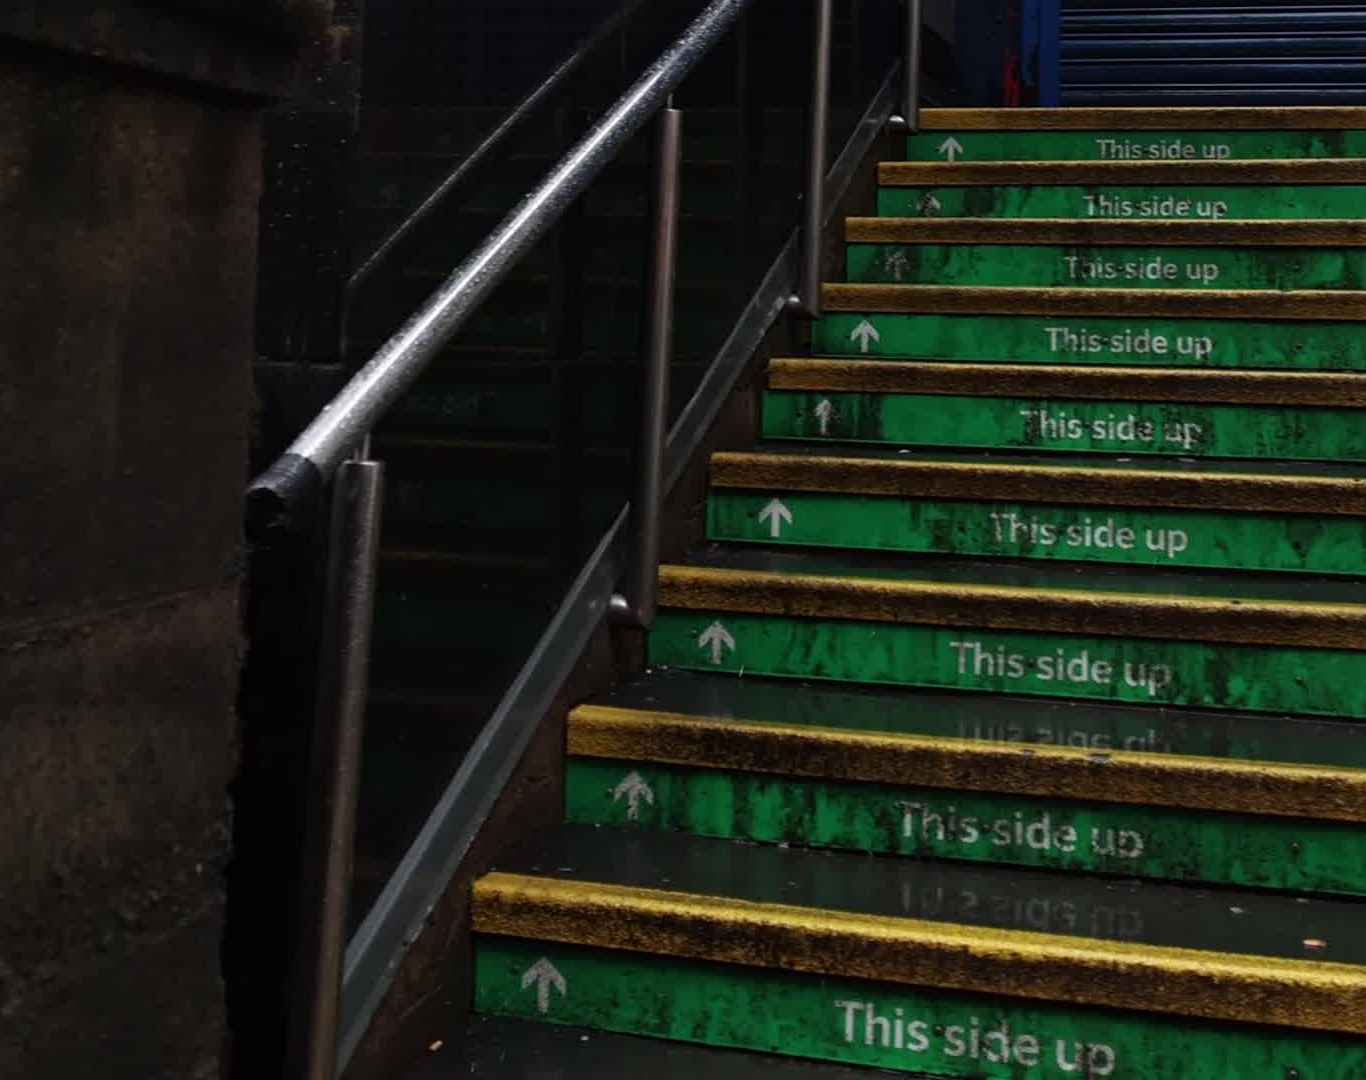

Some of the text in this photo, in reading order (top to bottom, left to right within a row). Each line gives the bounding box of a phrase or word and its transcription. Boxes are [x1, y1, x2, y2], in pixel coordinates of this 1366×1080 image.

[1096, 140, 1230, 159] This side up
[1083, 196, 1227, 219] This side up
[1124, 258, 1175, 280] side
[1187, 261, 1218, 282] up
[1045, 328, 1211, 359] This side up
[1091, 415, 1151, 441] side
[1163, 420, 1202, 447] up
[991, 513, 1188, 557] This side up
[949, 642, 1171, 695] This side up
[898, 802, 977, 844] This
[991, 810, 1077, 851] side
[838, 1000, 1115, 1075] This side up
